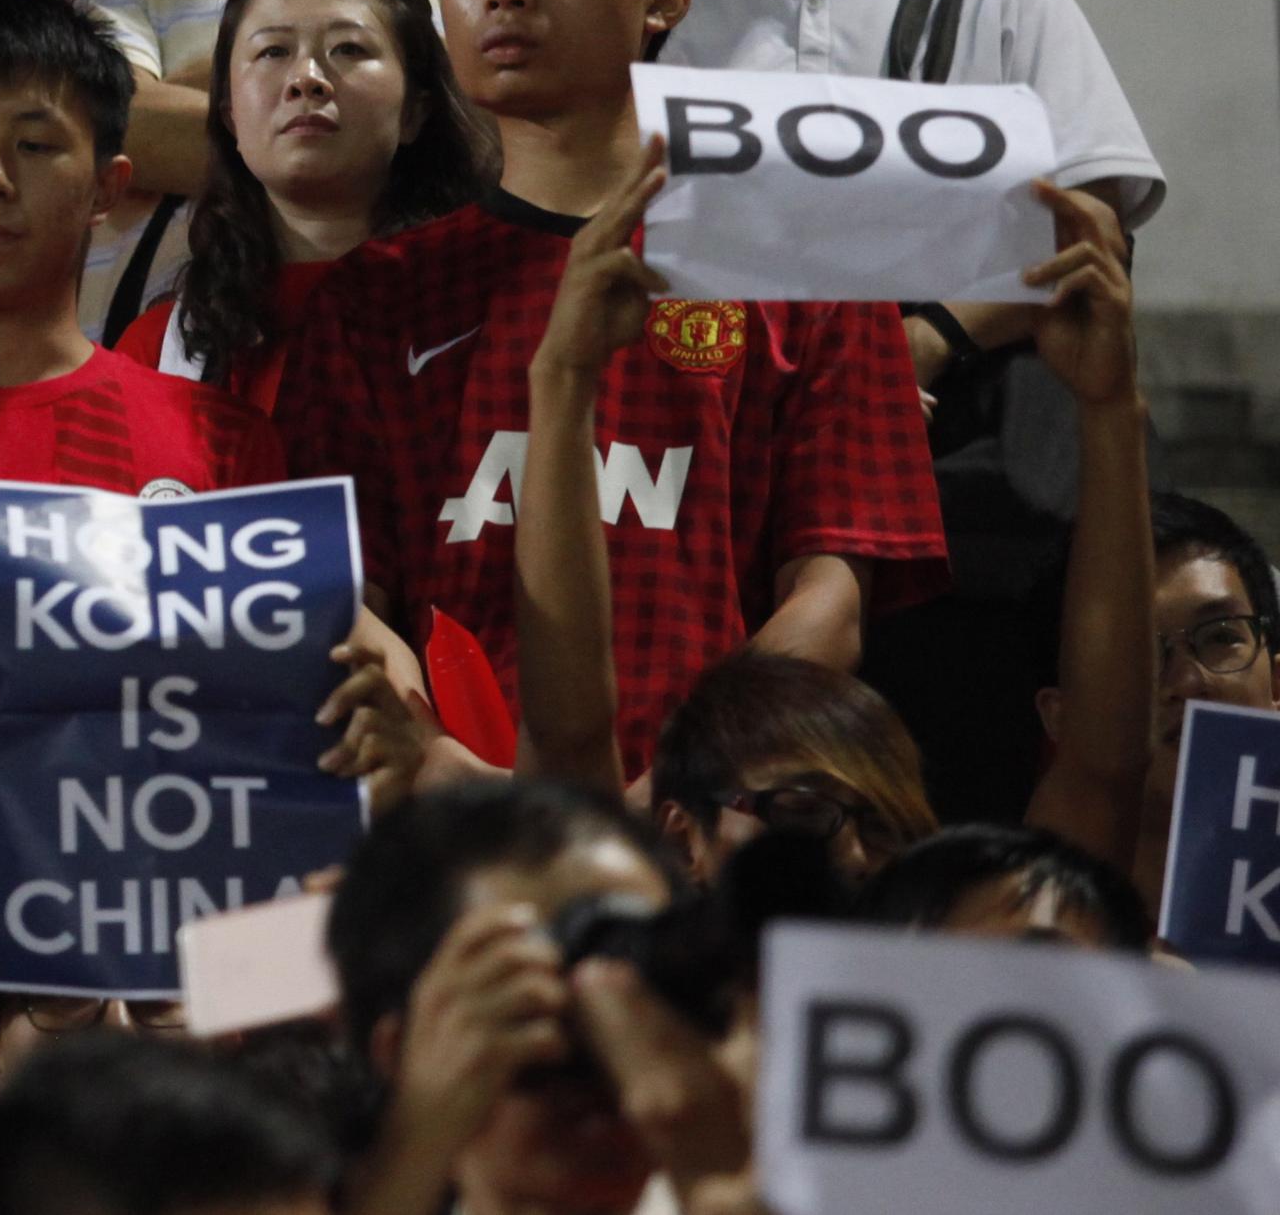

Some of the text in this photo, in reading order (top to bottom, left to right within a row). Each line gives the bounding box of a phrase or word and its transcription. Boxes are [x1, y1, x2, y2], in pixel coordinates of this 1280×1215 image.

[665, 96, 1008, 178] BOO
[437, 429, 694, 545] AN
[5, 504, 307, 576] HONG
[15, 577, 307, 651] KONG
[120, 675, 202, 751] IS
[58, 773, 268, 854] NOT
[4, 876, 304, 956] CHIN
[801, 997, 1240, 1179] BOO
